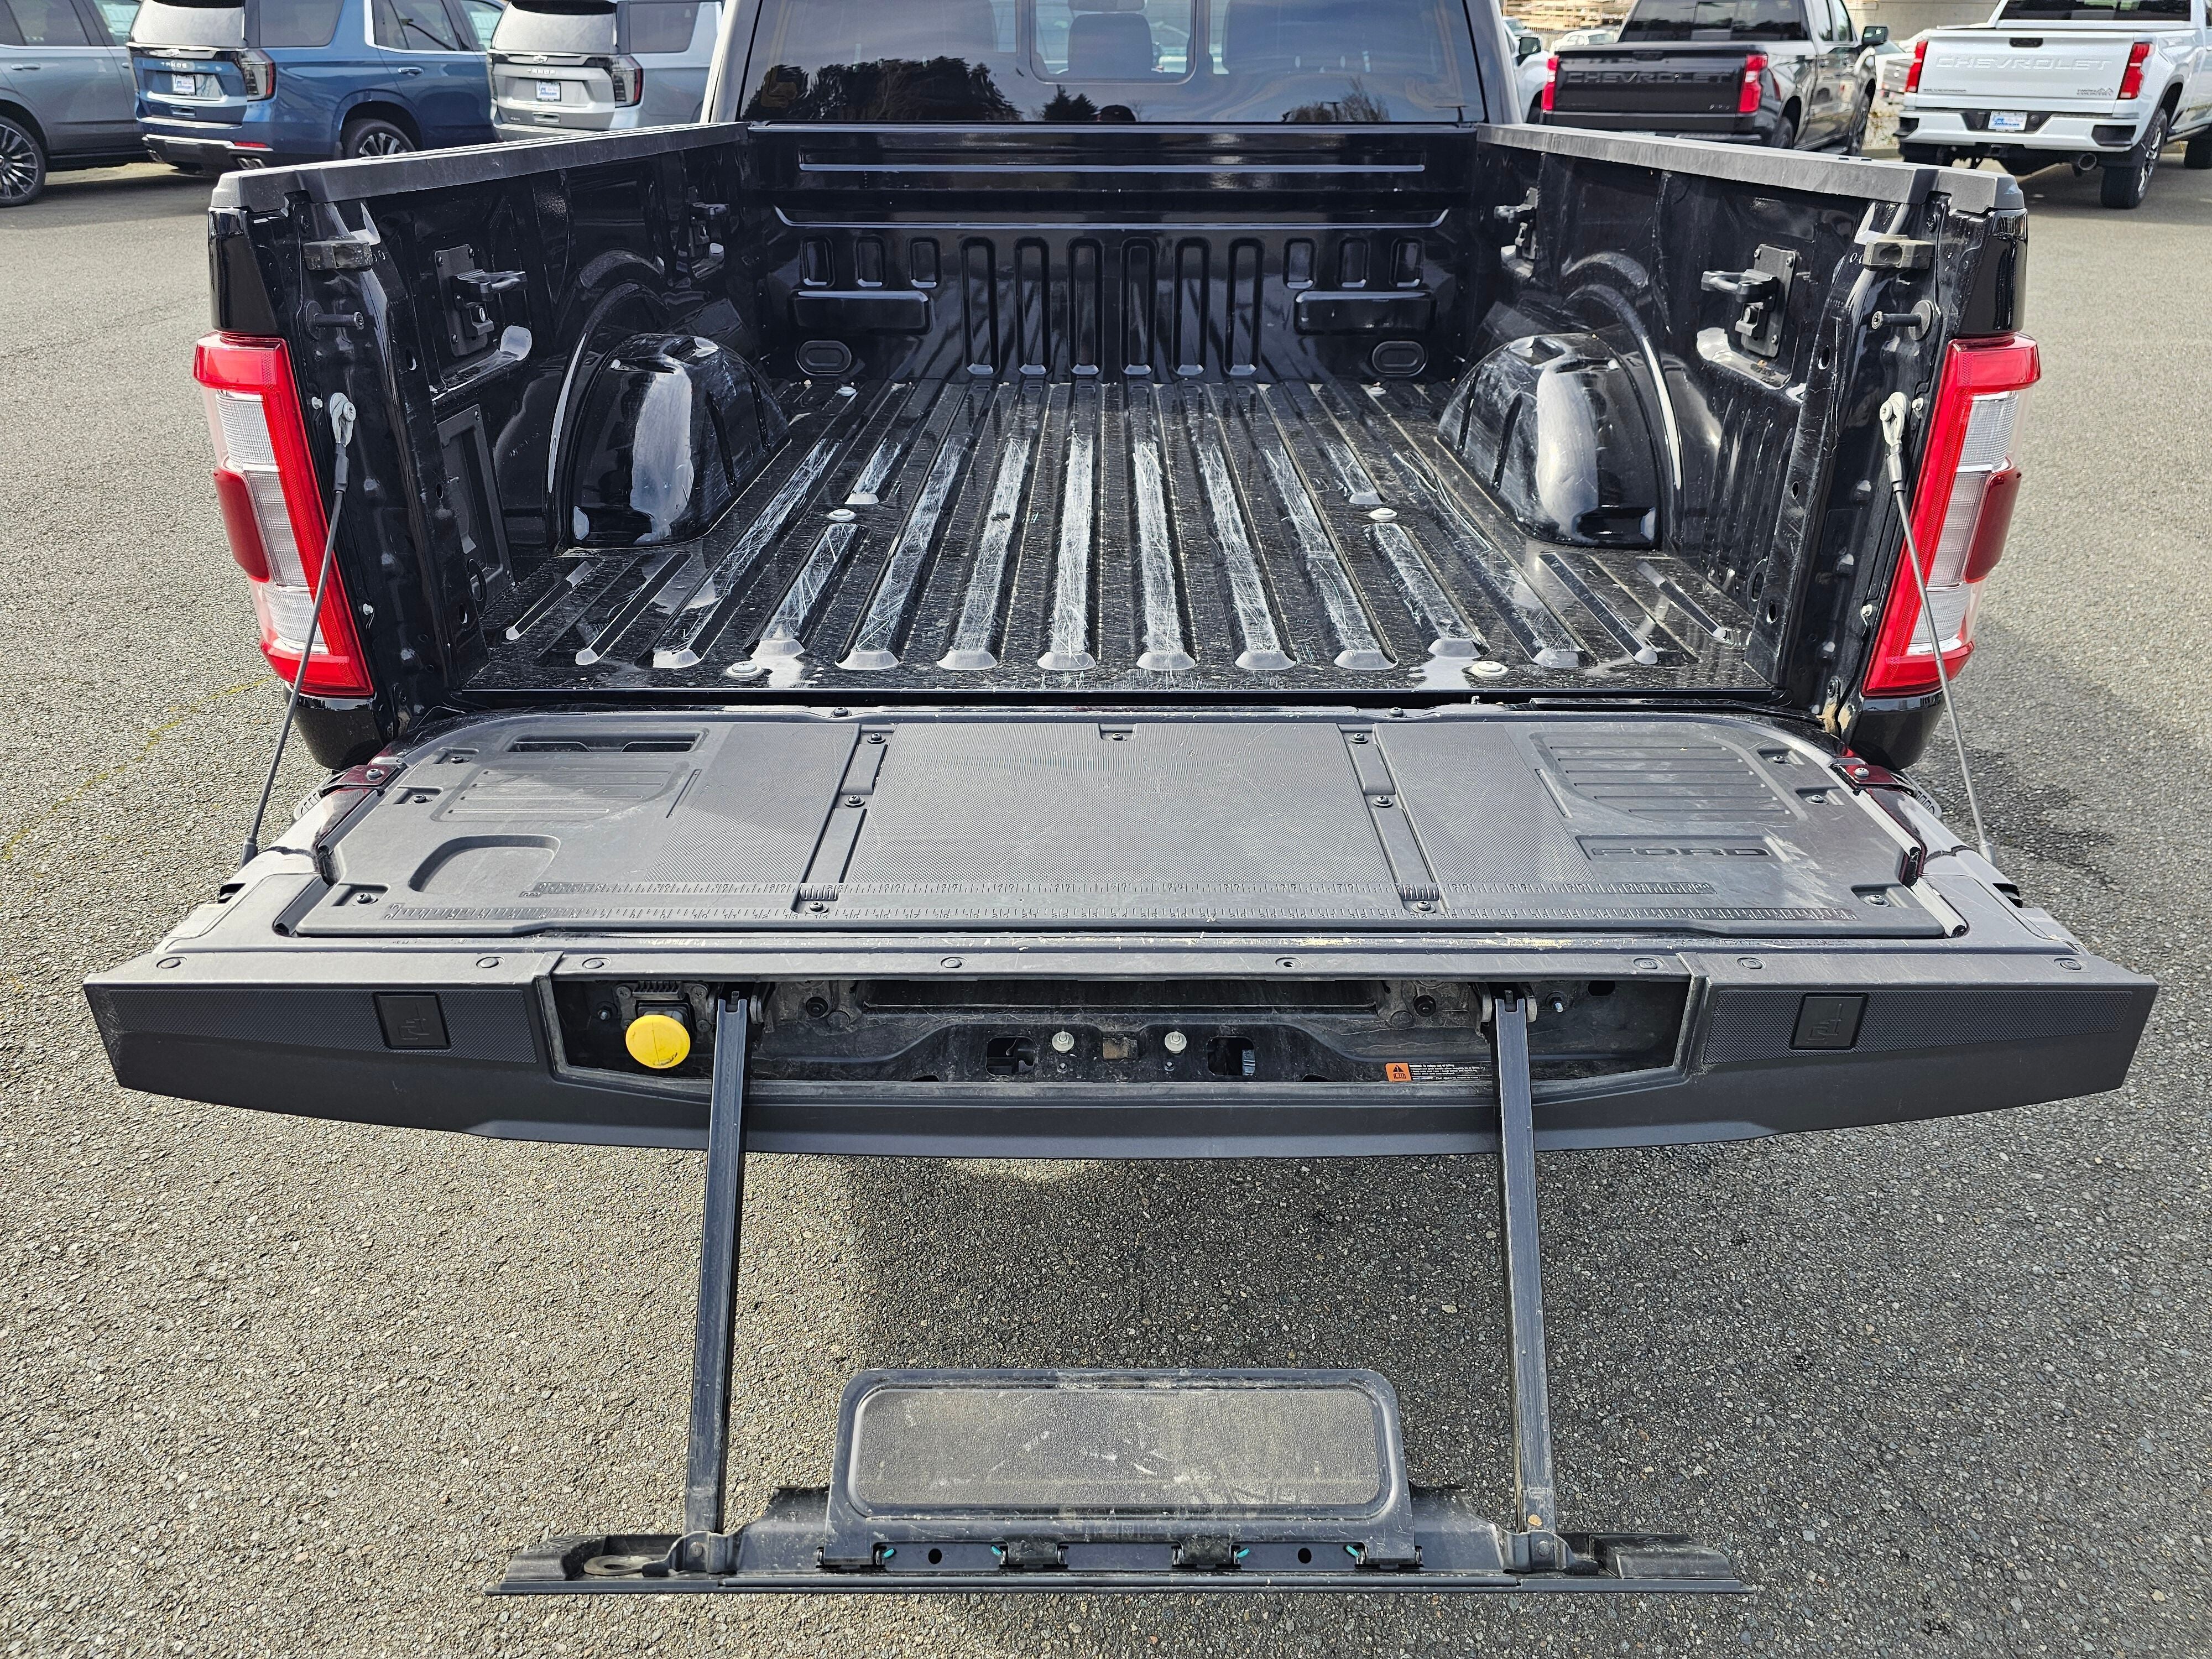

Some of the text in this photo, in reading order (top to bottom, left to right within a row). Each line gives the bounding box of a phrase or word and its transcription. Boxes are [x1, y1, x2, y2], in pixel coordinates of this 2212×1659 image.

[1936, 56, 2112, 71] CHEVROLET
[1566, 71, 1733, 84] CHEVROLET
[1591, 847, 1771, 857] FORD
